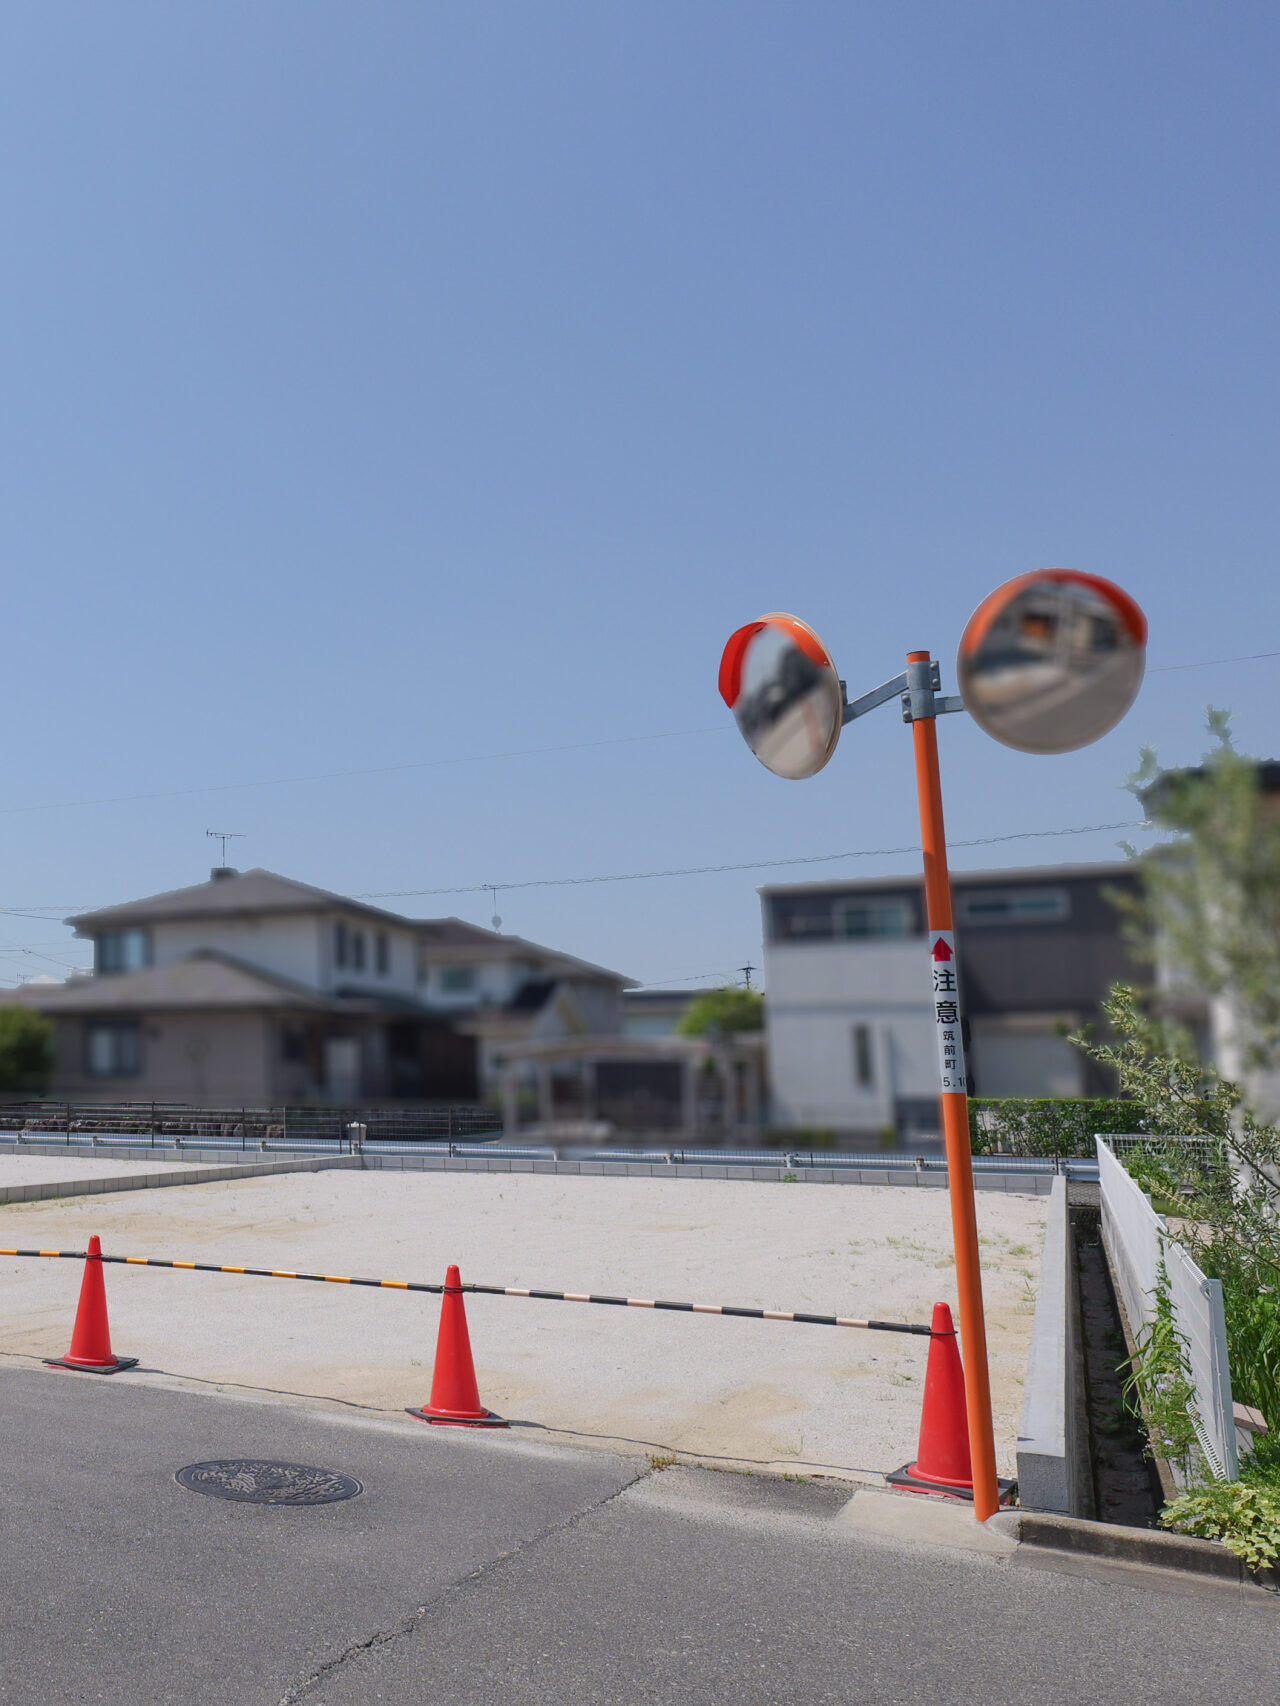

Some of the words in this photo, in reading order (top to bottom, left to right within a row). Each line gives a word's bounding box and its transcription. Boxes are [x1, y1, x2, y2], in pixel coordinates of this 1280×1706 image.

[933, 969, 959, 1024] 注意
[943, 1030, 957, 1070] 筑前町
